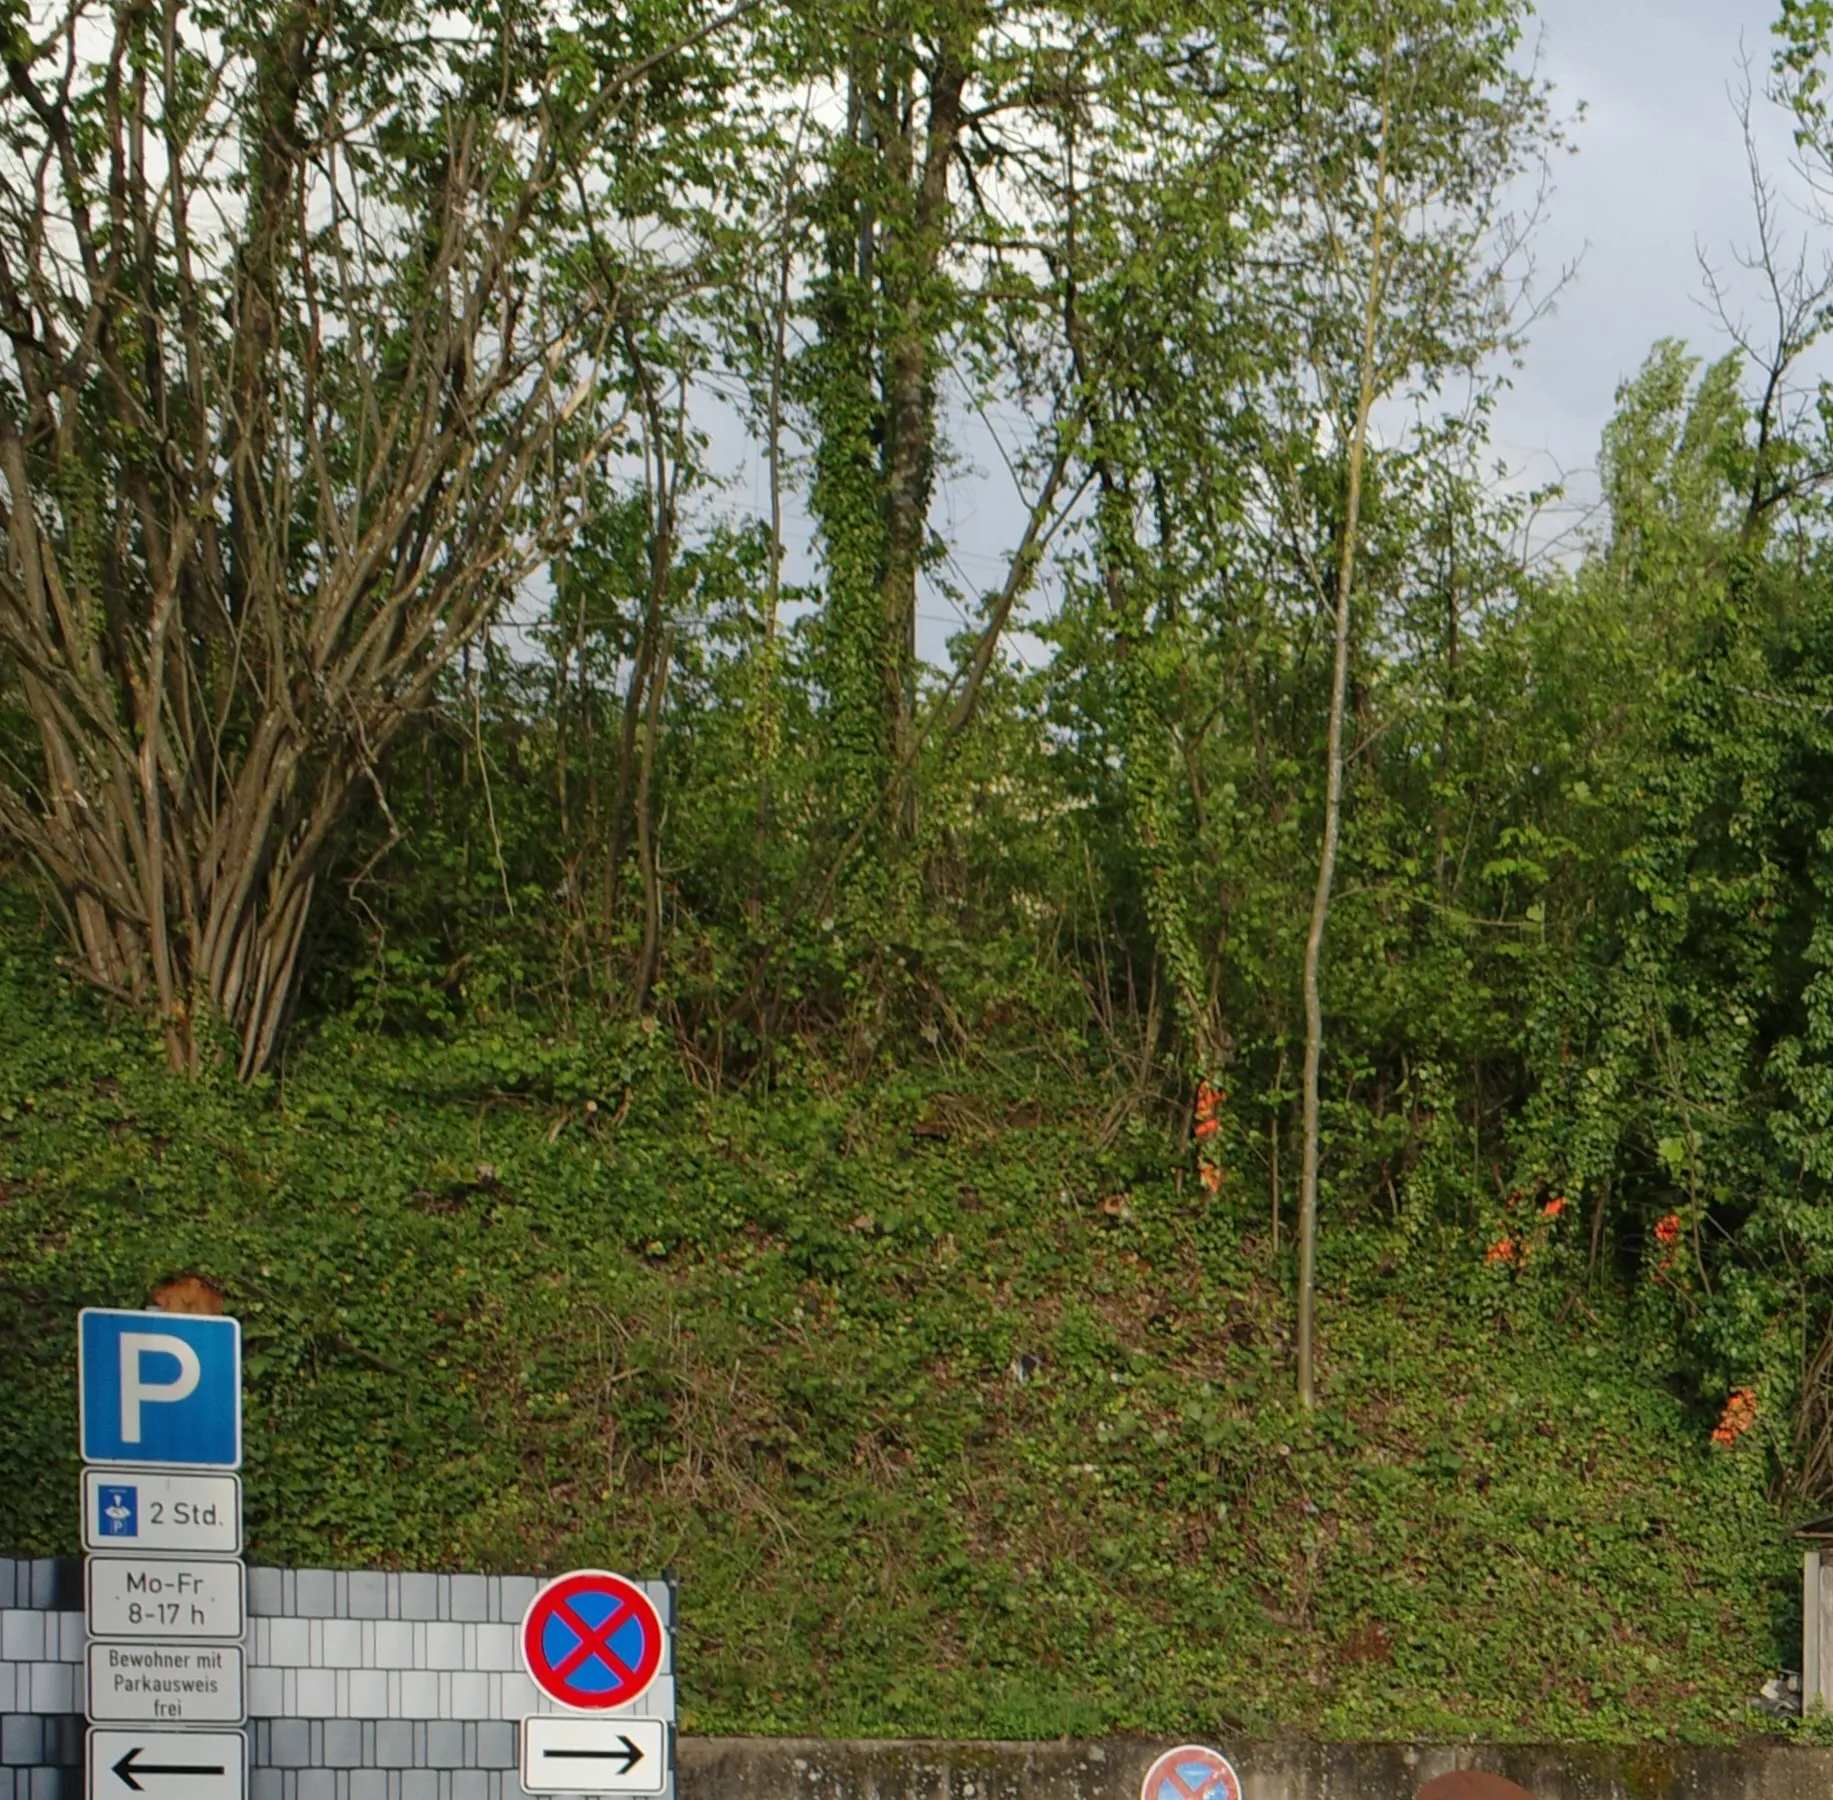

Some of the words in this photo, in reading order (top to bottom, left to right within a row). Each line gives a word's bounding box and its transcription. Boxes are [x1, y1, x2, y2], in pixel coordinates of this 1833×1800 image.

[120, 1331, 201, 1444] P
[150, 1501, 164, 1525] 2
[173, 1502, 224, 1527] Std.
[126, 1571, 204, 1594] Mo-Fr
[128, 1602, 180, 1625] 8-17
[191, 1603, 205, 1625] h
[109, 1649, 190, 1668] Bewohner
[196, 1651, 223, 1669] mit
[114, 1674, 219, 1693] Parkausweis
[154, 1699, 182, 1717] frei
